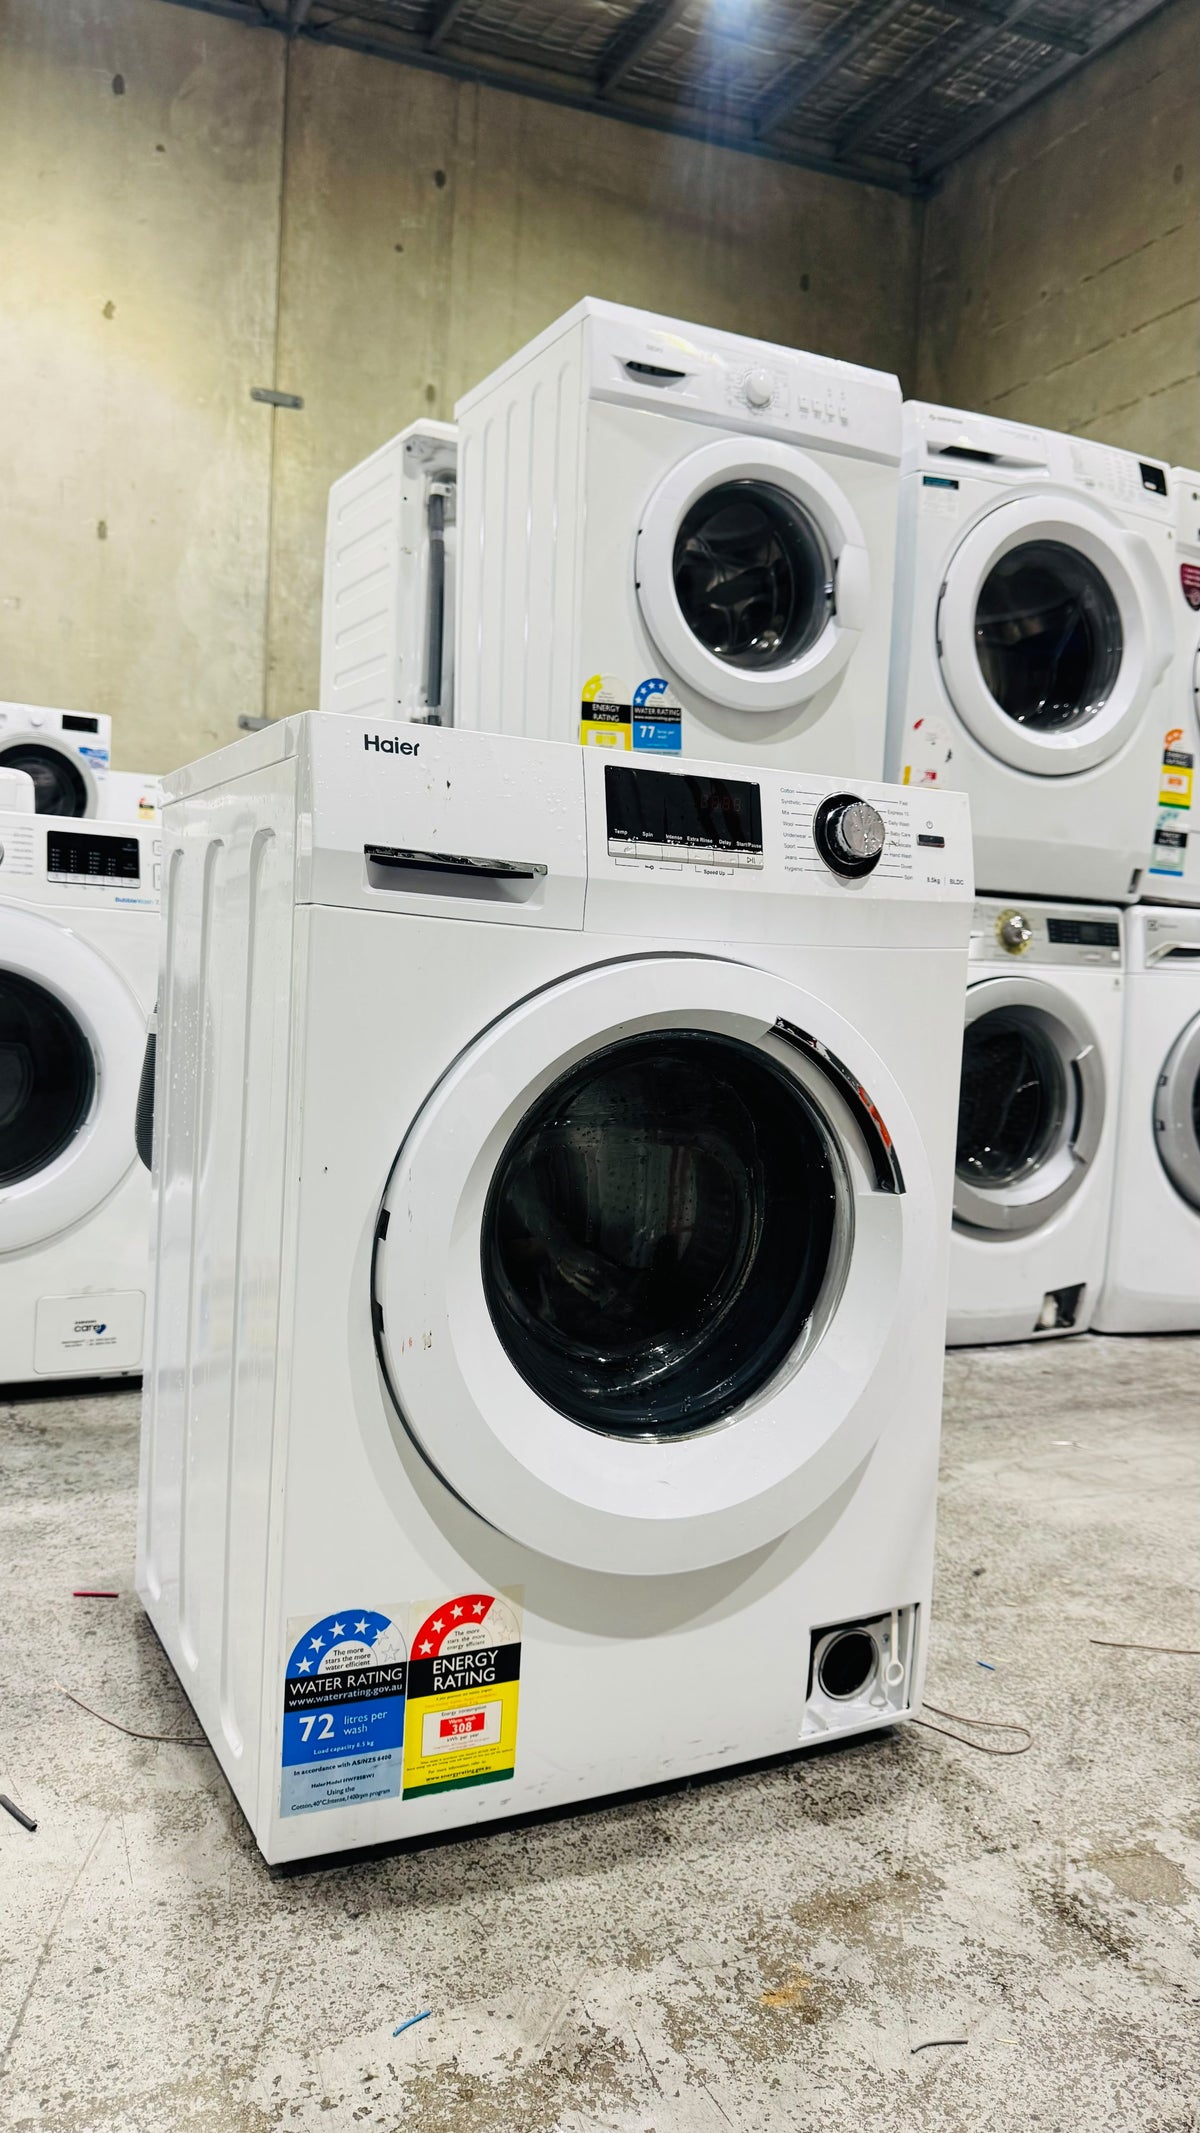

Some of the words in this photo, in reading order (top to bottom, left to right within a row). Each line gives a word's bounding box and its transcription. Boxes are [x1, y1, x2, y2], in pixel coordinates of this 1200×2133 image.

[592, 704, 620, 713] ENERGY
[592, 713, 620, 722] RATING
[640, 725, 655, 738] 77
[364, 733, 420, 756] Haier
[614, 828, 628, 836] Temp
[665, 833, 683, 841] Intense
[699, 836, 713, 844] Rinse
[346, 1647, 364, 1655] more
[325, 1657, 341, 1665] stars
[345, 1660, 370, 1668] efficient
[433, 1649, 499, 1675] ENERGY
[289, 1677, 343, 1696] WATER
[347, 1667, 402, 1688] RATING
[433, 1667, 496, 1691] RATING
[288, 1683, 403, 1706] www.waterrating.gov.au
[298, 1712, 335, 1742] 72
[344, 1714, 369, 1725] litres
[370, 1711, 388, 1723] per
[343, 1724, 368, 1736] wash
[451, 1721, 473, 1735] 308
[313, 1748, 330, 1756] Load
[330, 1743, 356, 1753] capacity
[301, 1764, 336, 1776] accordance
[326, 1788, 345, 1797] Using
[368, 1788, 391, 1799] program
